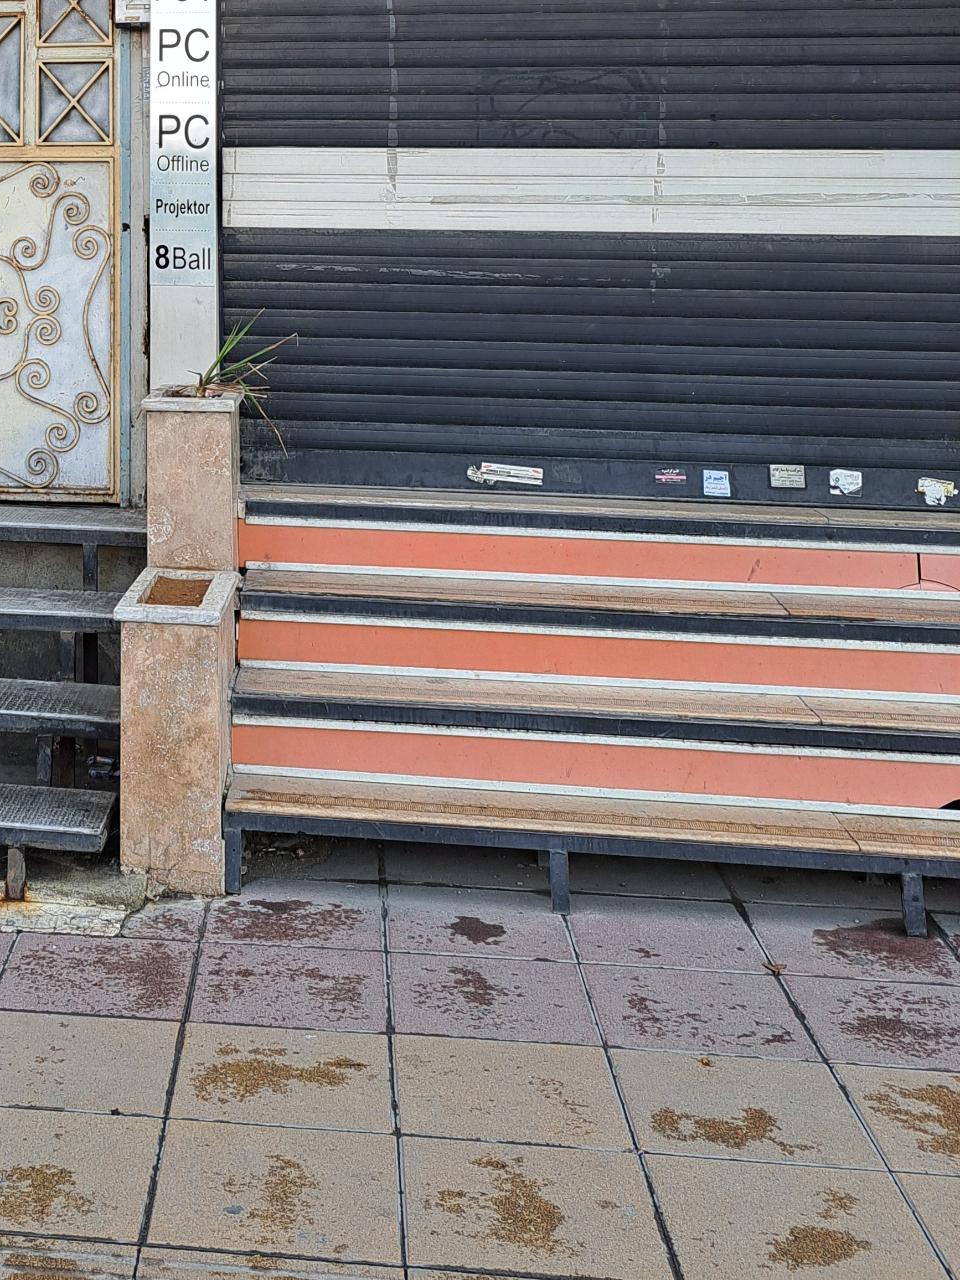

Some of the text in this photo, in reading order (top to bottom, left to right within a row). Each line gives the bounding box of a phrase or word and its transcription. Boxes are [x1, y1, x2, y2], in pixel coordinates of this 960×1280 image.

[158, 28, 210, 62] PC
[156, 71, 210, 88] Online
[158, 114, 210, 149] PC
[156, 155, 210, 173] Offline
[155, 199, 211, 219] Projektor
[155, 245, 211, 272] 8Ball
